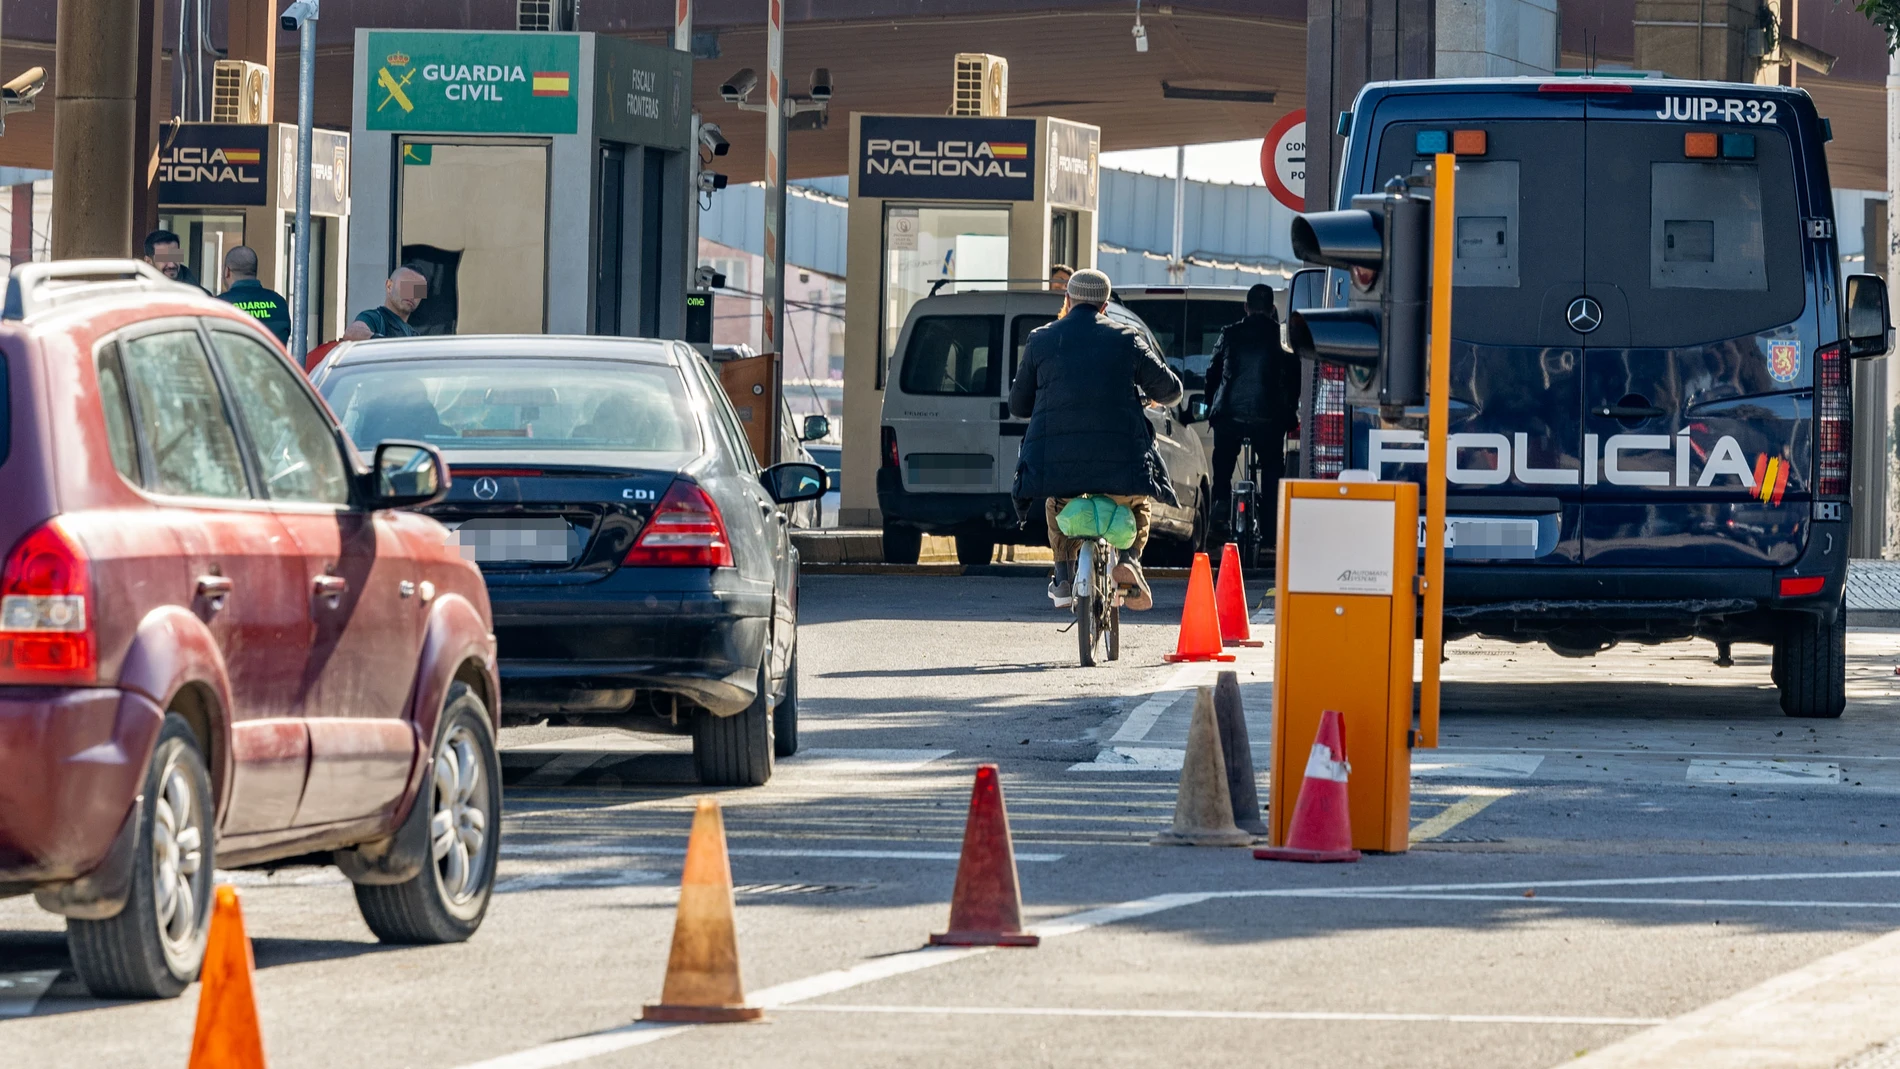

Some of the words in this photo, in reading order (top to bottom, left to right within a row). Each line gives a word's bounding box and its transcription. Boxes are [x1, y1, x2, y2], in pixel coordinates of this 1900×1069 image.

[422, 64, 526, 82] GUARDIA
[632, 68, 650, 93] FISCAL
[650, 71, 656, 93] Y
[445, 84, 503, 101] CIVIL
[626, 93, 659, 119] FRONTERAS
[1656, 96, 1777, 124] JUIP-R32
[867, 158, 1026, 177] NACIONAL
[1059, 155, 1088, 175] FRONTERAS
[247, 309, 271, 318] IVIL
[1367, 424, 1758, 488] POLICÍA
[621, 488, 655, 500] CDI
